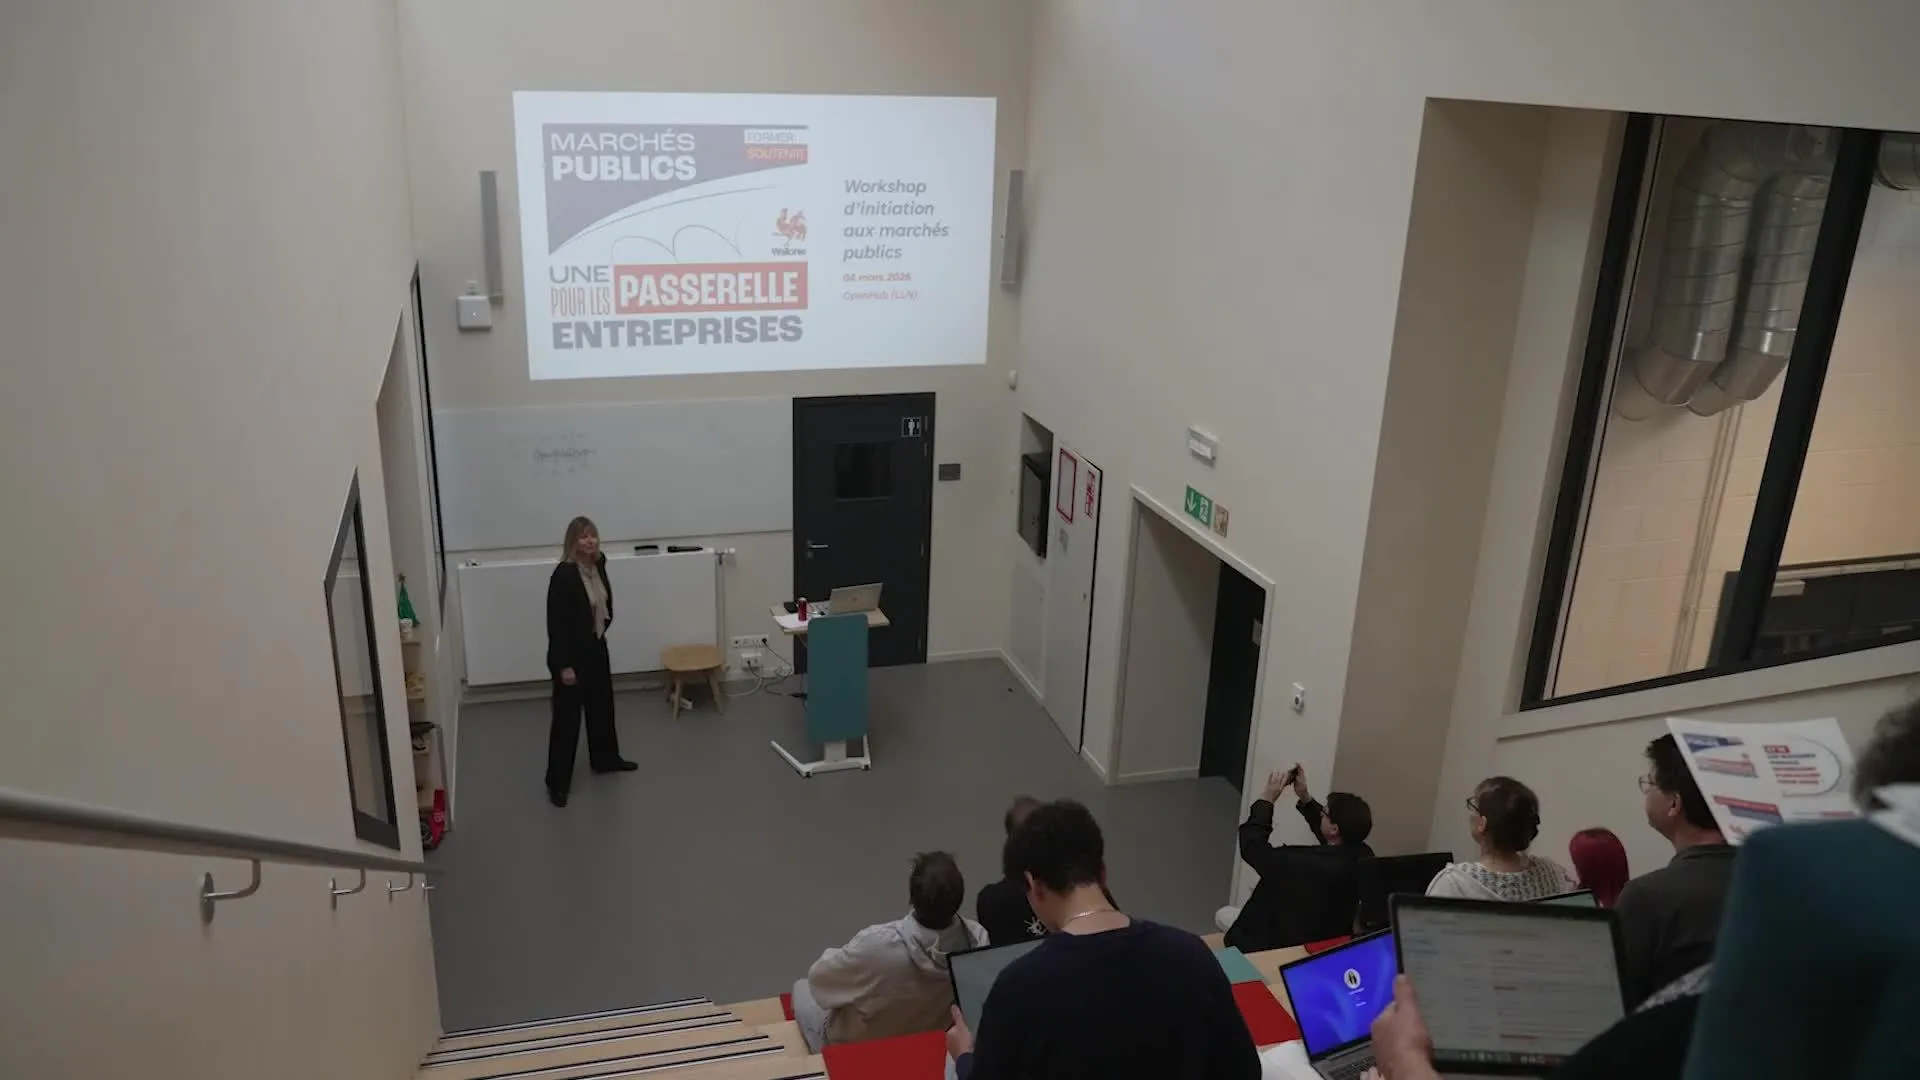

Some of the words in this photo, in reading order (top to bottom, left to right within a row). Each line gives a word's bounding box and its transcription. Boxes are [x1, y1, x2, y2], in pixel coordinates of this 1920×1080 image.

[550, 128, 696, 151] MARCHÉS
[551, 155, 697, 181] PUBLICS
[844, 179, 927, 196] Workshop
[844, 200, 935, 216] d'initiation
[843, 224, 874, 238] aux
[878, 221, 950, 238] marchés
[843, 244, 903, 263] publics
[549, 264, 610, 284] UNE
[843, 273, 857, 282] 04
[618, 271, 799, 308] PASSERELLE
[550, 286, 586, 317] POUR
[590, 286, 611, 316] LES
[551, 314, 804, 350] ENTREPRISES
